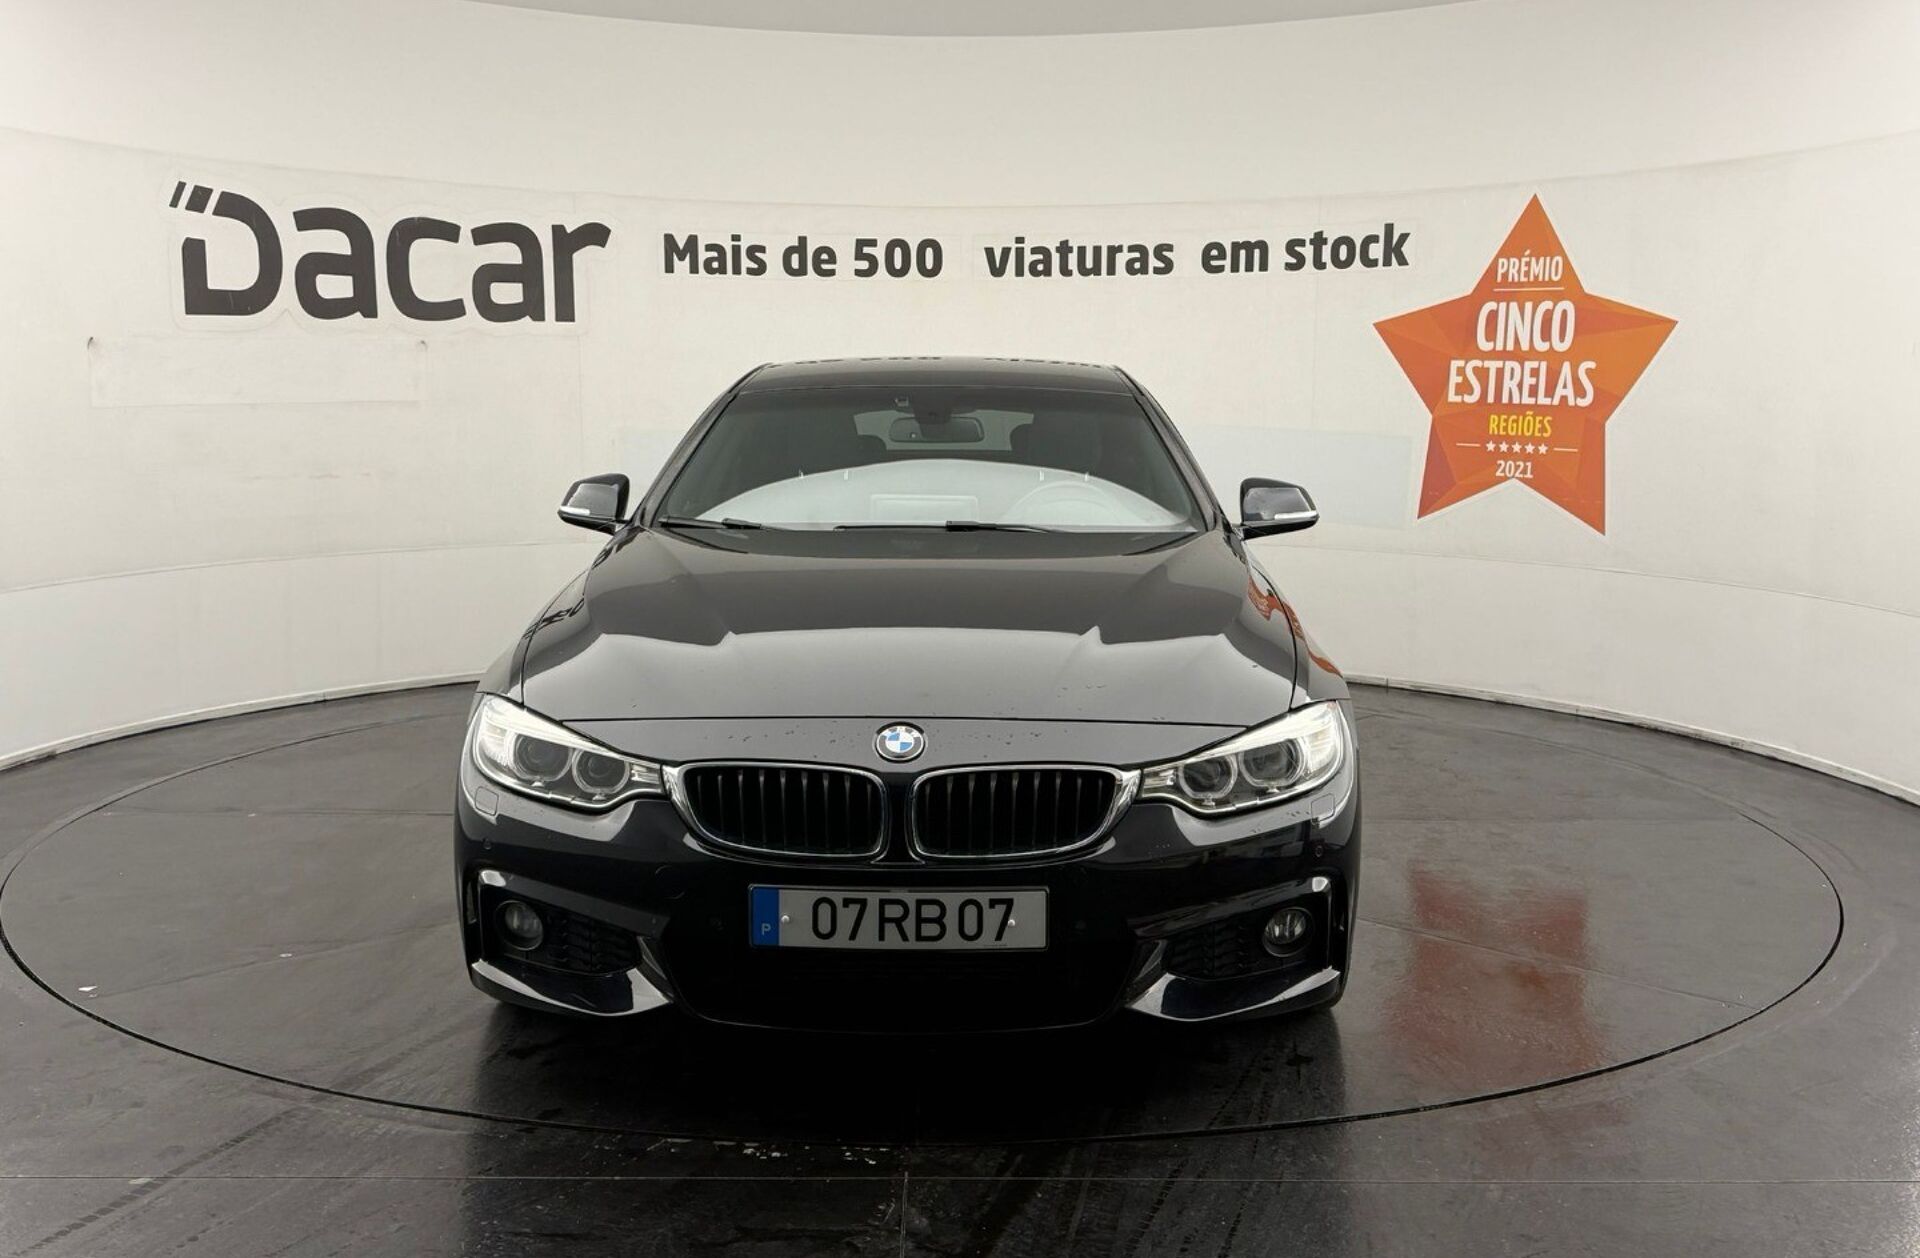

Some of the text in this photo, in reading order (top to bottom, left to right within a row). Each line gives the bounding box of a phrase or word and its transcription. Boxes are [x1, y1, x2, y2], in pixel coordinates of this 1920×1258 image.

[168, 181, 612, 323] Dacar
[663, 222, 1411, 279] Mais de 500 viaturas em stock
[1496, 250, 1563, 283] PRÉMIO
[1476, 300, 1576, 352] CINCO
[1447, 359, 1597, 407] ESTRELAS
[1488, 411, 1553, 438] REGIÕES
[1495, 460, 1534, 479] 2021
[761, 923, 772, 936] P
